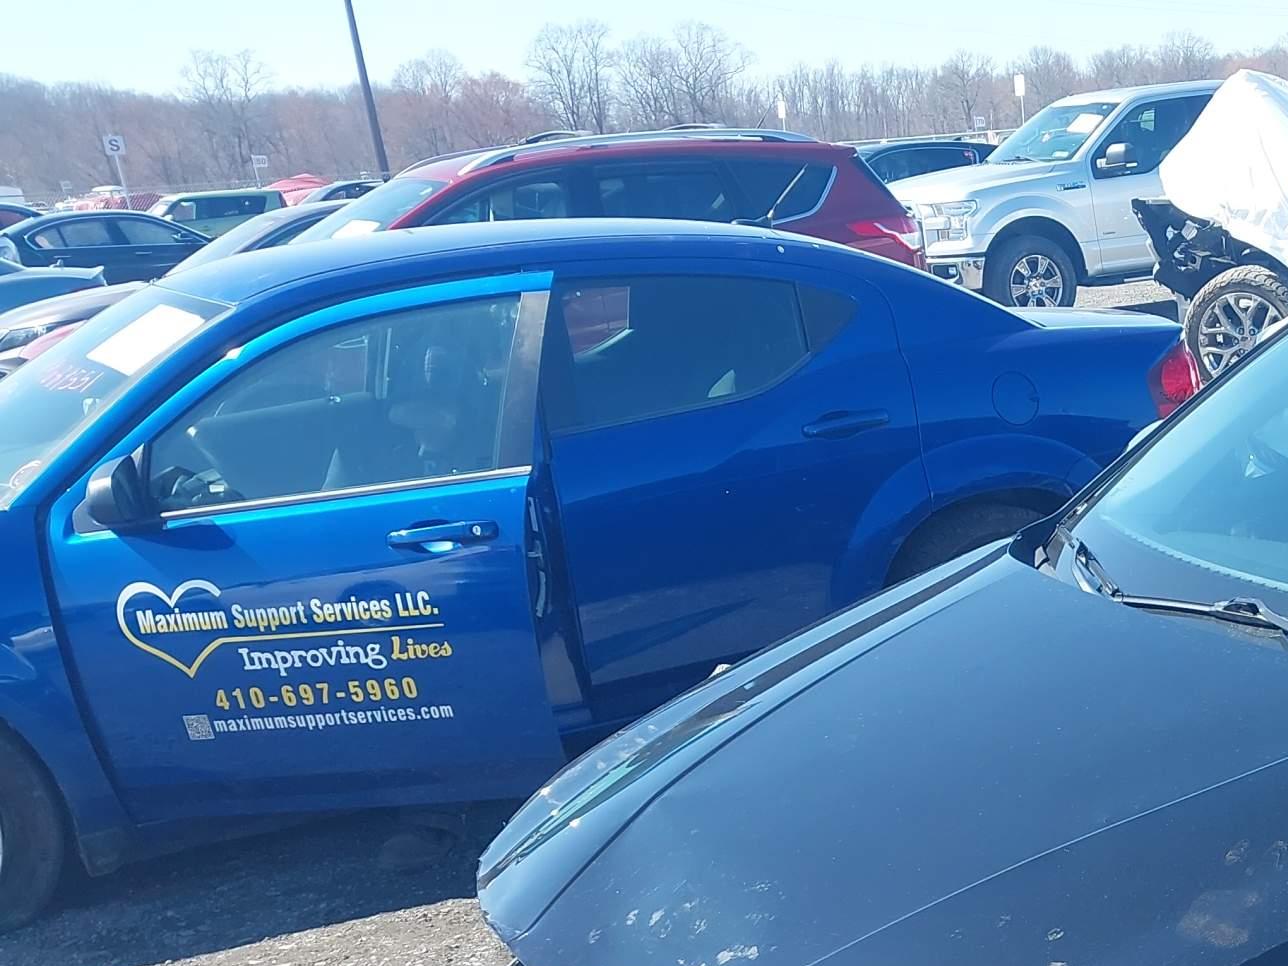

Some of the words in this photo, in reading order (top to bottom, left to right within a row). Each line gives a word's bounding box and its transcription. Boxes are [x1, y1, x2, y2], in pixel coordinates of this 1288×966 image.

[108, 138, 121, 152] S
[135, 607, 229, 634] Maximum
[231, 601, 308, 632] Support
[310, 596, 393, 623] Services
[394, 590, 439, 617] LLC.
[238, 639, 388, 677] Improving
[391, 635, 453, 660] Lives
[215, 676, 418, 711] 410-697-5960
[213, 704, 454, 733] maximumsupportservices.com
